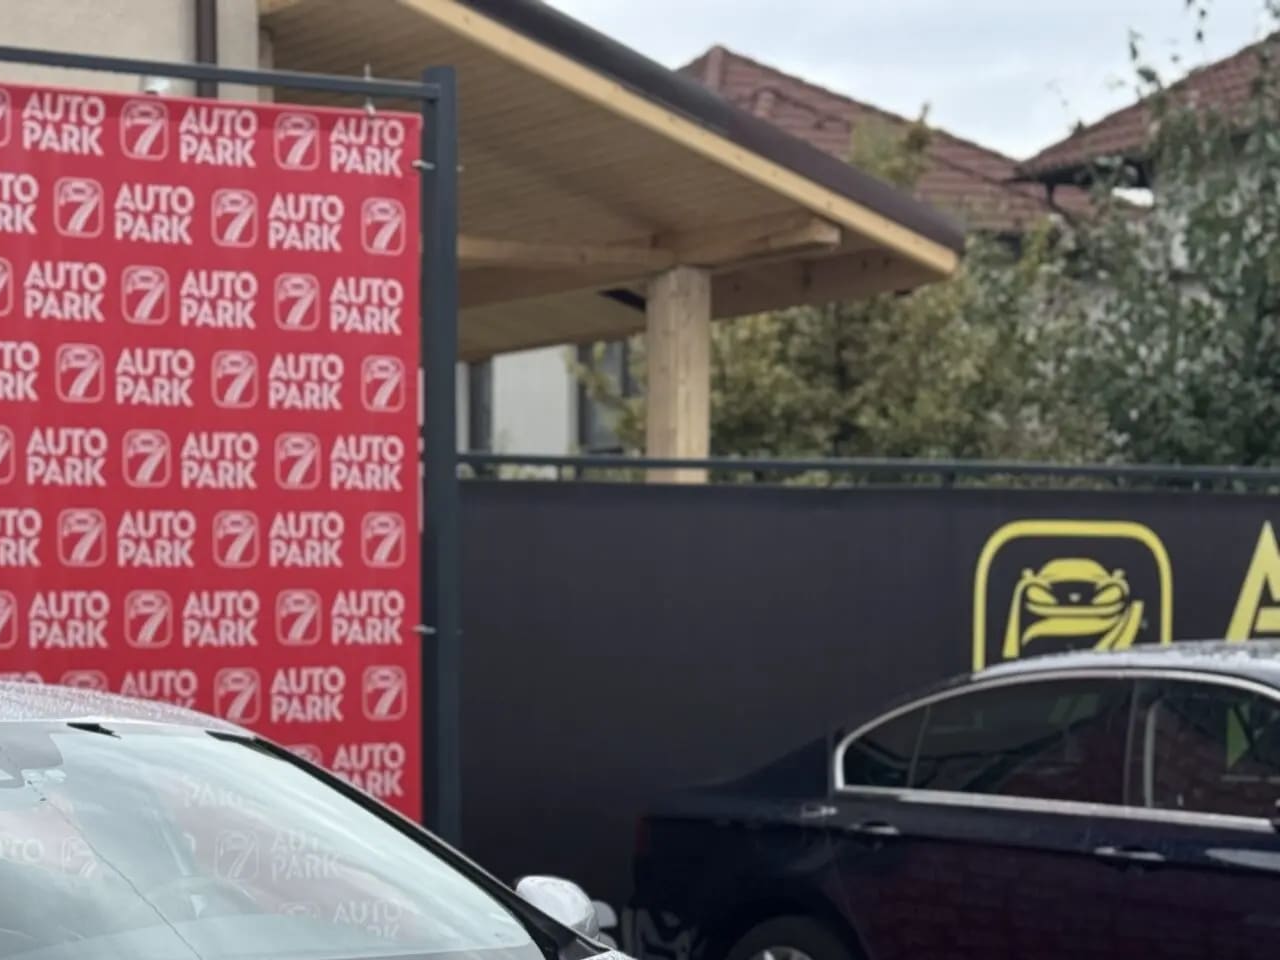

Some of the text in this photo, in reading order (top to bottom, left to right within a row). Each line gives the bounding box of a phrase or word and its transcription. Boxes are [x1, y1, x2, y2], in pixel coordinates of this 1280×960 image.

[23, 92, 105, 125] AUTO
[179, 106, 257, 138] AUTO
[23, 118, 103, 156] PARK
[329, 117, 406, 148] AUTO
[180, 131, 256, 168] PARK
[330, 141, 402, 178] PARK
[114, 183, 194, 216] AUTO
[268, 192, 344, 225] AUTO
[115, 209, 192, 245] PARK
[268, 218, 341, 253] PARK
[24, 260, 106, 292] AUTO
[180, 270, 258, 301] AUTO
[330, 276, 403, 307] AUTO
[24, 286, 104, 323] PARK
[181, 295, 255, 329] PARK
[330, 302, 401, 336] PARK
[116, 347, 195, 378] AUTO
[268, 352, 344, 383] AUTO
[116, 374, 193, 408] PARK
[269, 379, 342, 411] PARK
[26, 426, 108, 458] AUTO
[181, 431, 259, 461] AUTO
[330, 434, 404, 464] AUTO
[27, 454, 106, 487] PARK
[182, 458, 256, 490] PARK
[330, 460, 402, 492] PARK
[117, 509, 196, 540] AUTO
[269, 510, 344, 540] AUTO
[118, 537, 194, 568] PARK
[269, 538, 342, 568] PARK
[28, 590, 110, 620] AUTO
[183, 589, 259, 619] AUTO
[331, 589, 405, 617] AUTO
[29, 618, 107, 649] PARK
[183, 617, 257, 647] PARK
[332, 616, 402, 645] PARK
[120, 669, 198, 700] AUTO
[271, 666, 345, 695] AUTO
[271, 693, 343, 722] PARK
[332, 742, 405, 771] AUTO
